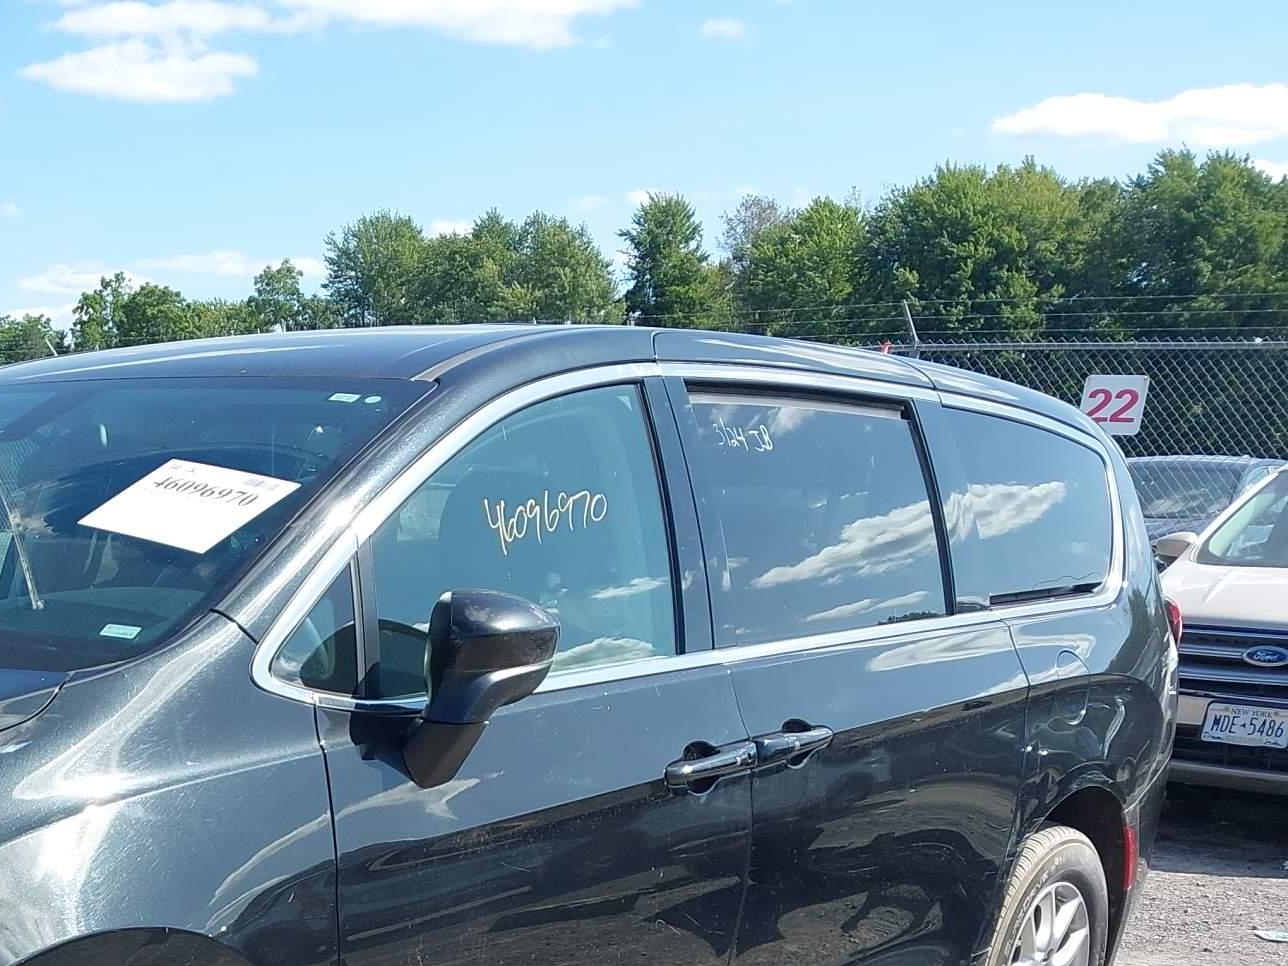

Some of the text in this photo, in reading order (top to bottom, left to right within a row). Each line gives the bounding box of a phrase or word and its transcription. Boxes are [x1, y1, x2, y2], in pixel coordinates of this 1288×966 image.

[1085, 387, 1140, 424] 22
[153, 476, 260, 507] 46096970
[483, 490, 608, 556] 46096970
[1253, 650, 1280, 662] Ford
[1211, 713, 1285, 738] MDE 5486
[1232, 707, 1273, 719] NEW YORK
